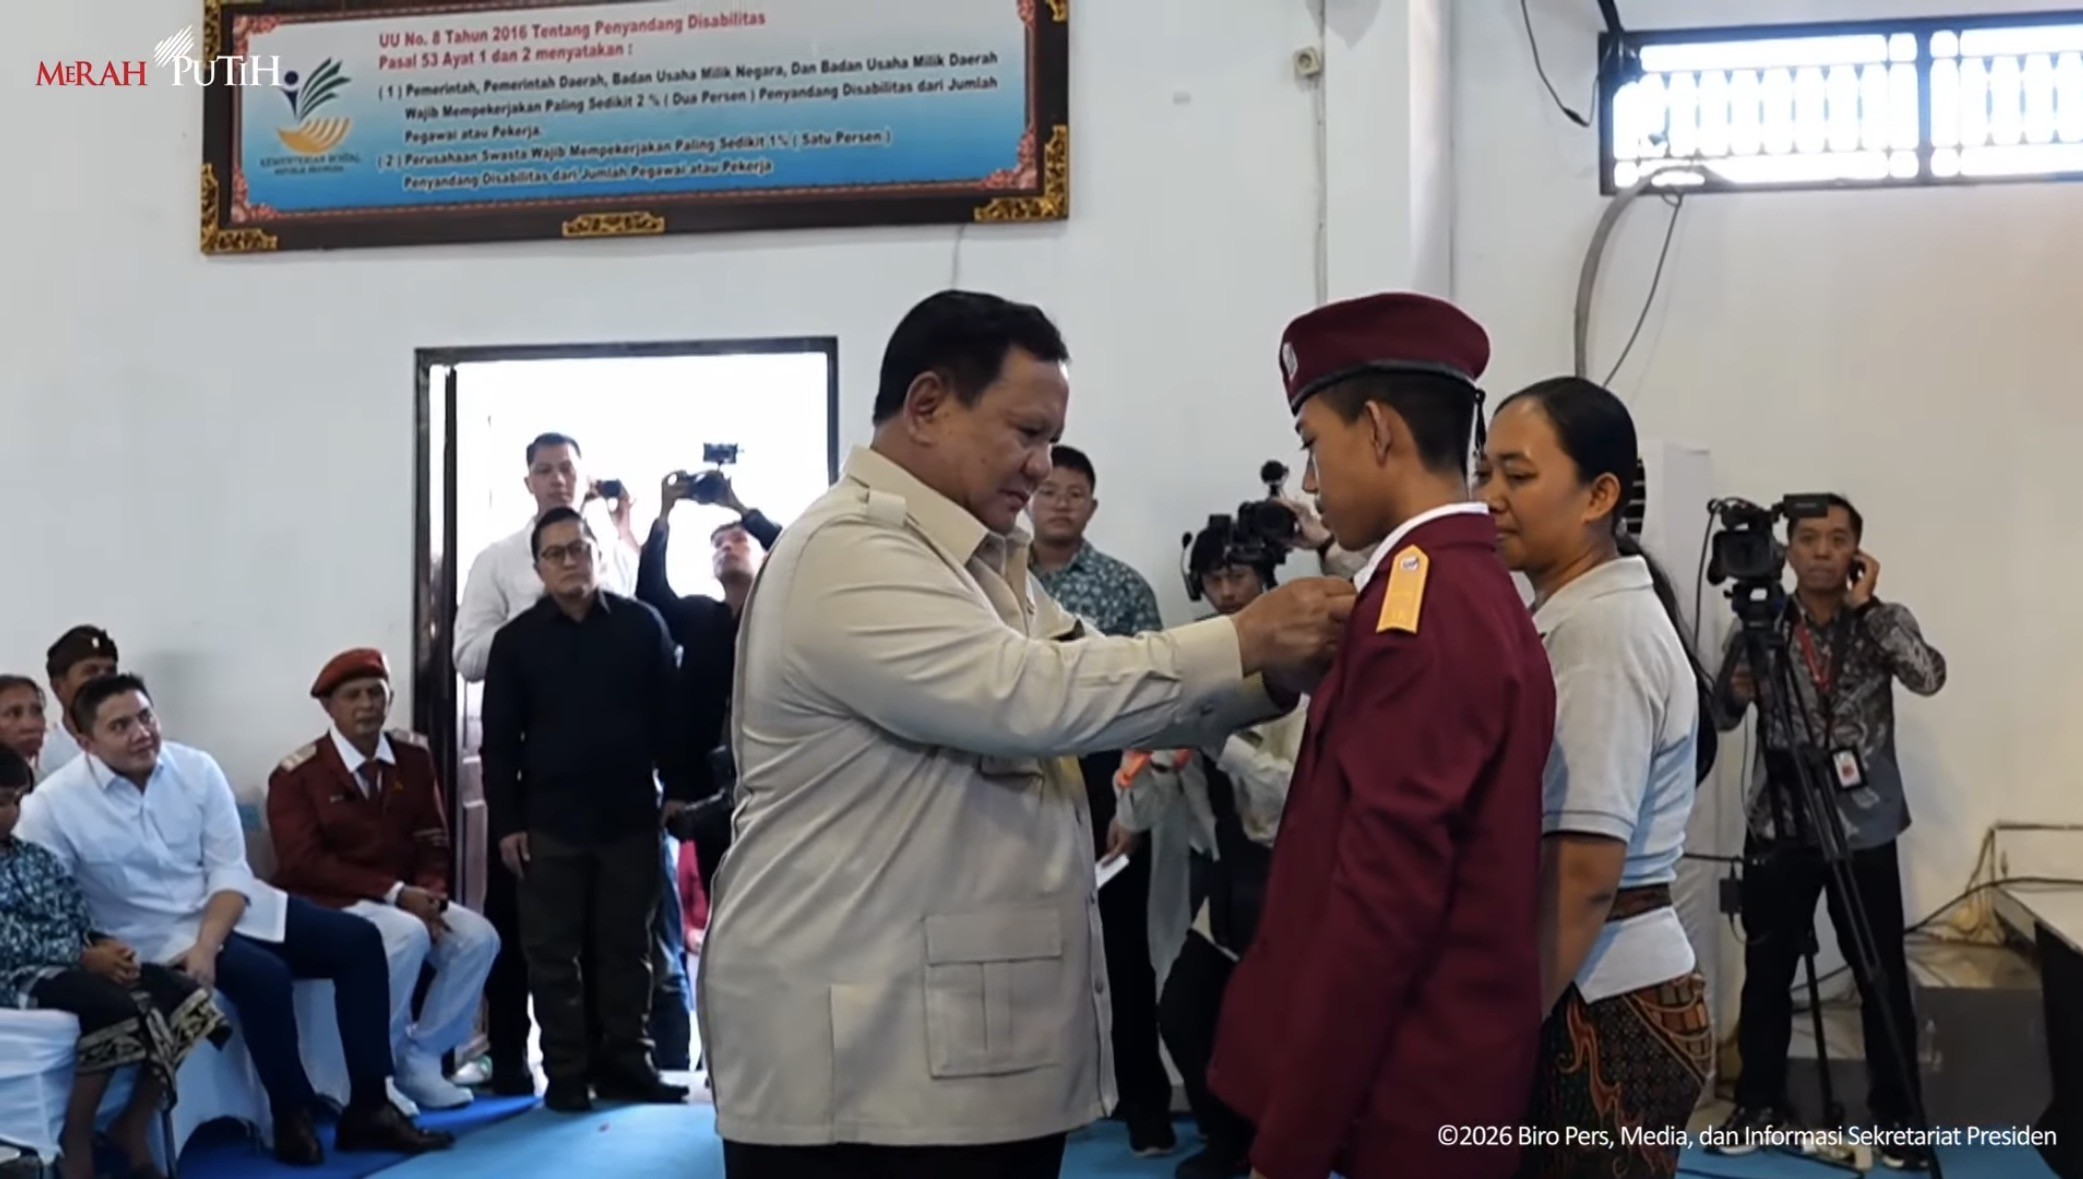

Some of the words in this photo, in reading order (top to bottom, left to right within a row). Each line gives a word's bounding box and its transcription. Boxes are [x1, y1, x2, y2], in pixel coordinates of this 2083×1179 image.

[379, 34, 400, 48] UU
[405, 32, 427, 46] No.
[432, 30, 440, 45] 8
[445, 29, 488, 44] Tahun
[493, 25, 528, 41] 2016
[532, 22, 590, 40] Tentang
[595, 18, 683, 37] Penyandang
[688, 12, 766, 29] Disabilitas
[379, 53, 416, 70] Pasal
[421, 52, 438, 68] 53
[443, 51, 474, 69] Ayat
[480, 50, 486, 63] 1
[491, 49, 518, 63] dan
[522, 47, 531, 62] 2
[535, 42, 624, 63] menyatakan
[406, 80, 480, 97] Pemerintah,
[484, 75, 556, 93] Pemerintah
[559, 73, 608, 88] Daerah,
[612, 70, 652, 85] Badan
[656, 68, 697, 83] Usaha
[701, 66, 731, 80] Milik
[735, 64, 788, 80] Negara,
[791, 61, 817, 75] Dan
[821, 59, 862, 74] Badan
[866, 57, 908, 72] Usaha
[913, 55, 944, 68] Milik
[949, 51, 998, 67] Daerah
[405, 107, 438, 122] Wajib
[442, 101, 541, 119] Mempekerjakan
[545, 97, 584, 113] Paling
[588, 95, 632, 110] Sedikit
[673, 91, 698, 106] Dua
[702, 89, 746, 104] Persen
[759, 85, 839, 103] Penyandang
[843, 80, 913, 96] Disabilitas
[917, 79, 943, 94] dari
[948, 76, 998, 91] Jumlah
[405, 129, 457, 145] Pegawai
[461, 128, 488, 140] atau
[405, 151, 478, 166] Perusahaan
[482, 149, 527, 162] Swasta
[531, 146, 566, 161] Wajib
[570, 141, 671, 158] Mempekerjakan
[675, 137, 715, 153] Paling
[720, 135, 764, 149] Sedikit
[802, 131, 832, 145] Satu
[836, 130, 882, 144] Persen
[404, 173, 479, 190] Penyandang
[482, 170, 548, 185] Disabilitas
[552, 168, 577, 182] dari
[582, 164, 627, 179] Jumlah
[631, 162, 686, 179] Pegawai
[690, 161, 719, 174] atau
[723, 159, 772, 175] Pekerja
